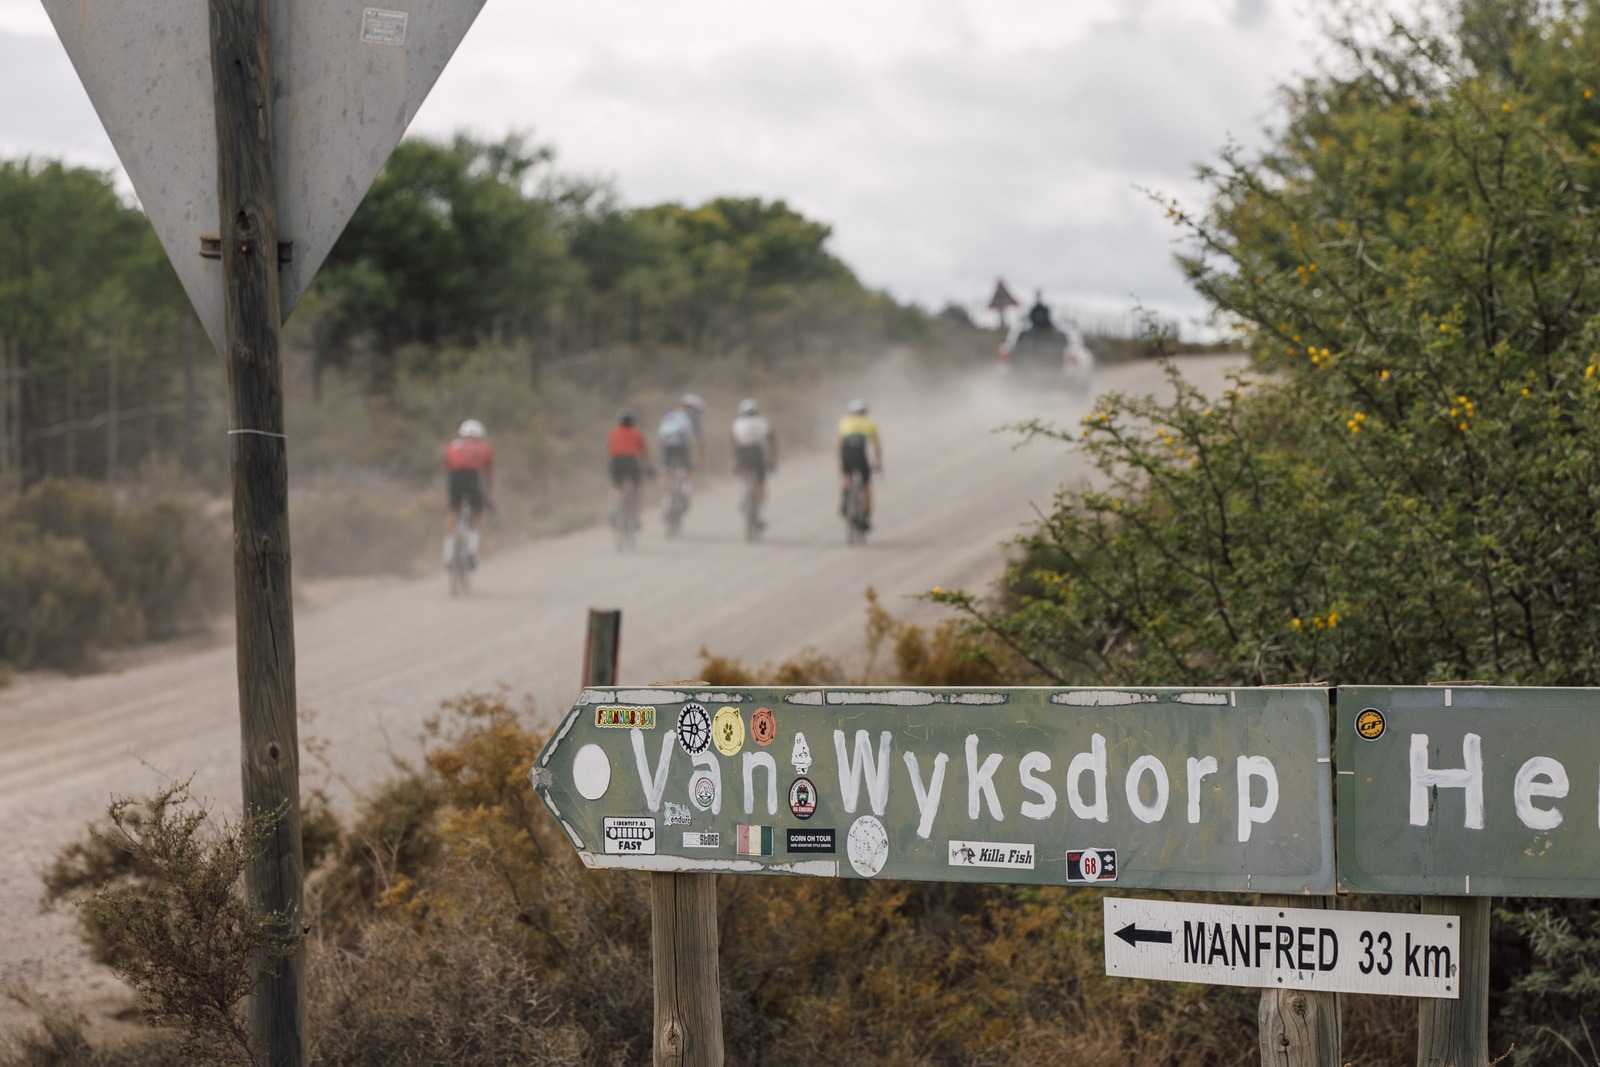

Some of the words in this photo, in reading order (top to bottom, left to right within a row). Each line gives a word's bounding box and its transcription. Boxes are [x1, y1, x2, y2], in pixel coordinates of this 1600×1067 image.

[630, 729, 778, 816] Van
[833, 729, 1280, 842] Wyksdorp
[1409, 732, 1600, 831] He
[618, 841, 642, 850] FAST
[979, 848, 1005, 863] Killa
[1008, 849, 1032, 864] Fish
[1084, 857, 1097, 875] 68
[1184, 920, 1339, 972] MANFRED
[1359, 930, 1393, 976] 33
[1405, 932, 1452, 978] km
